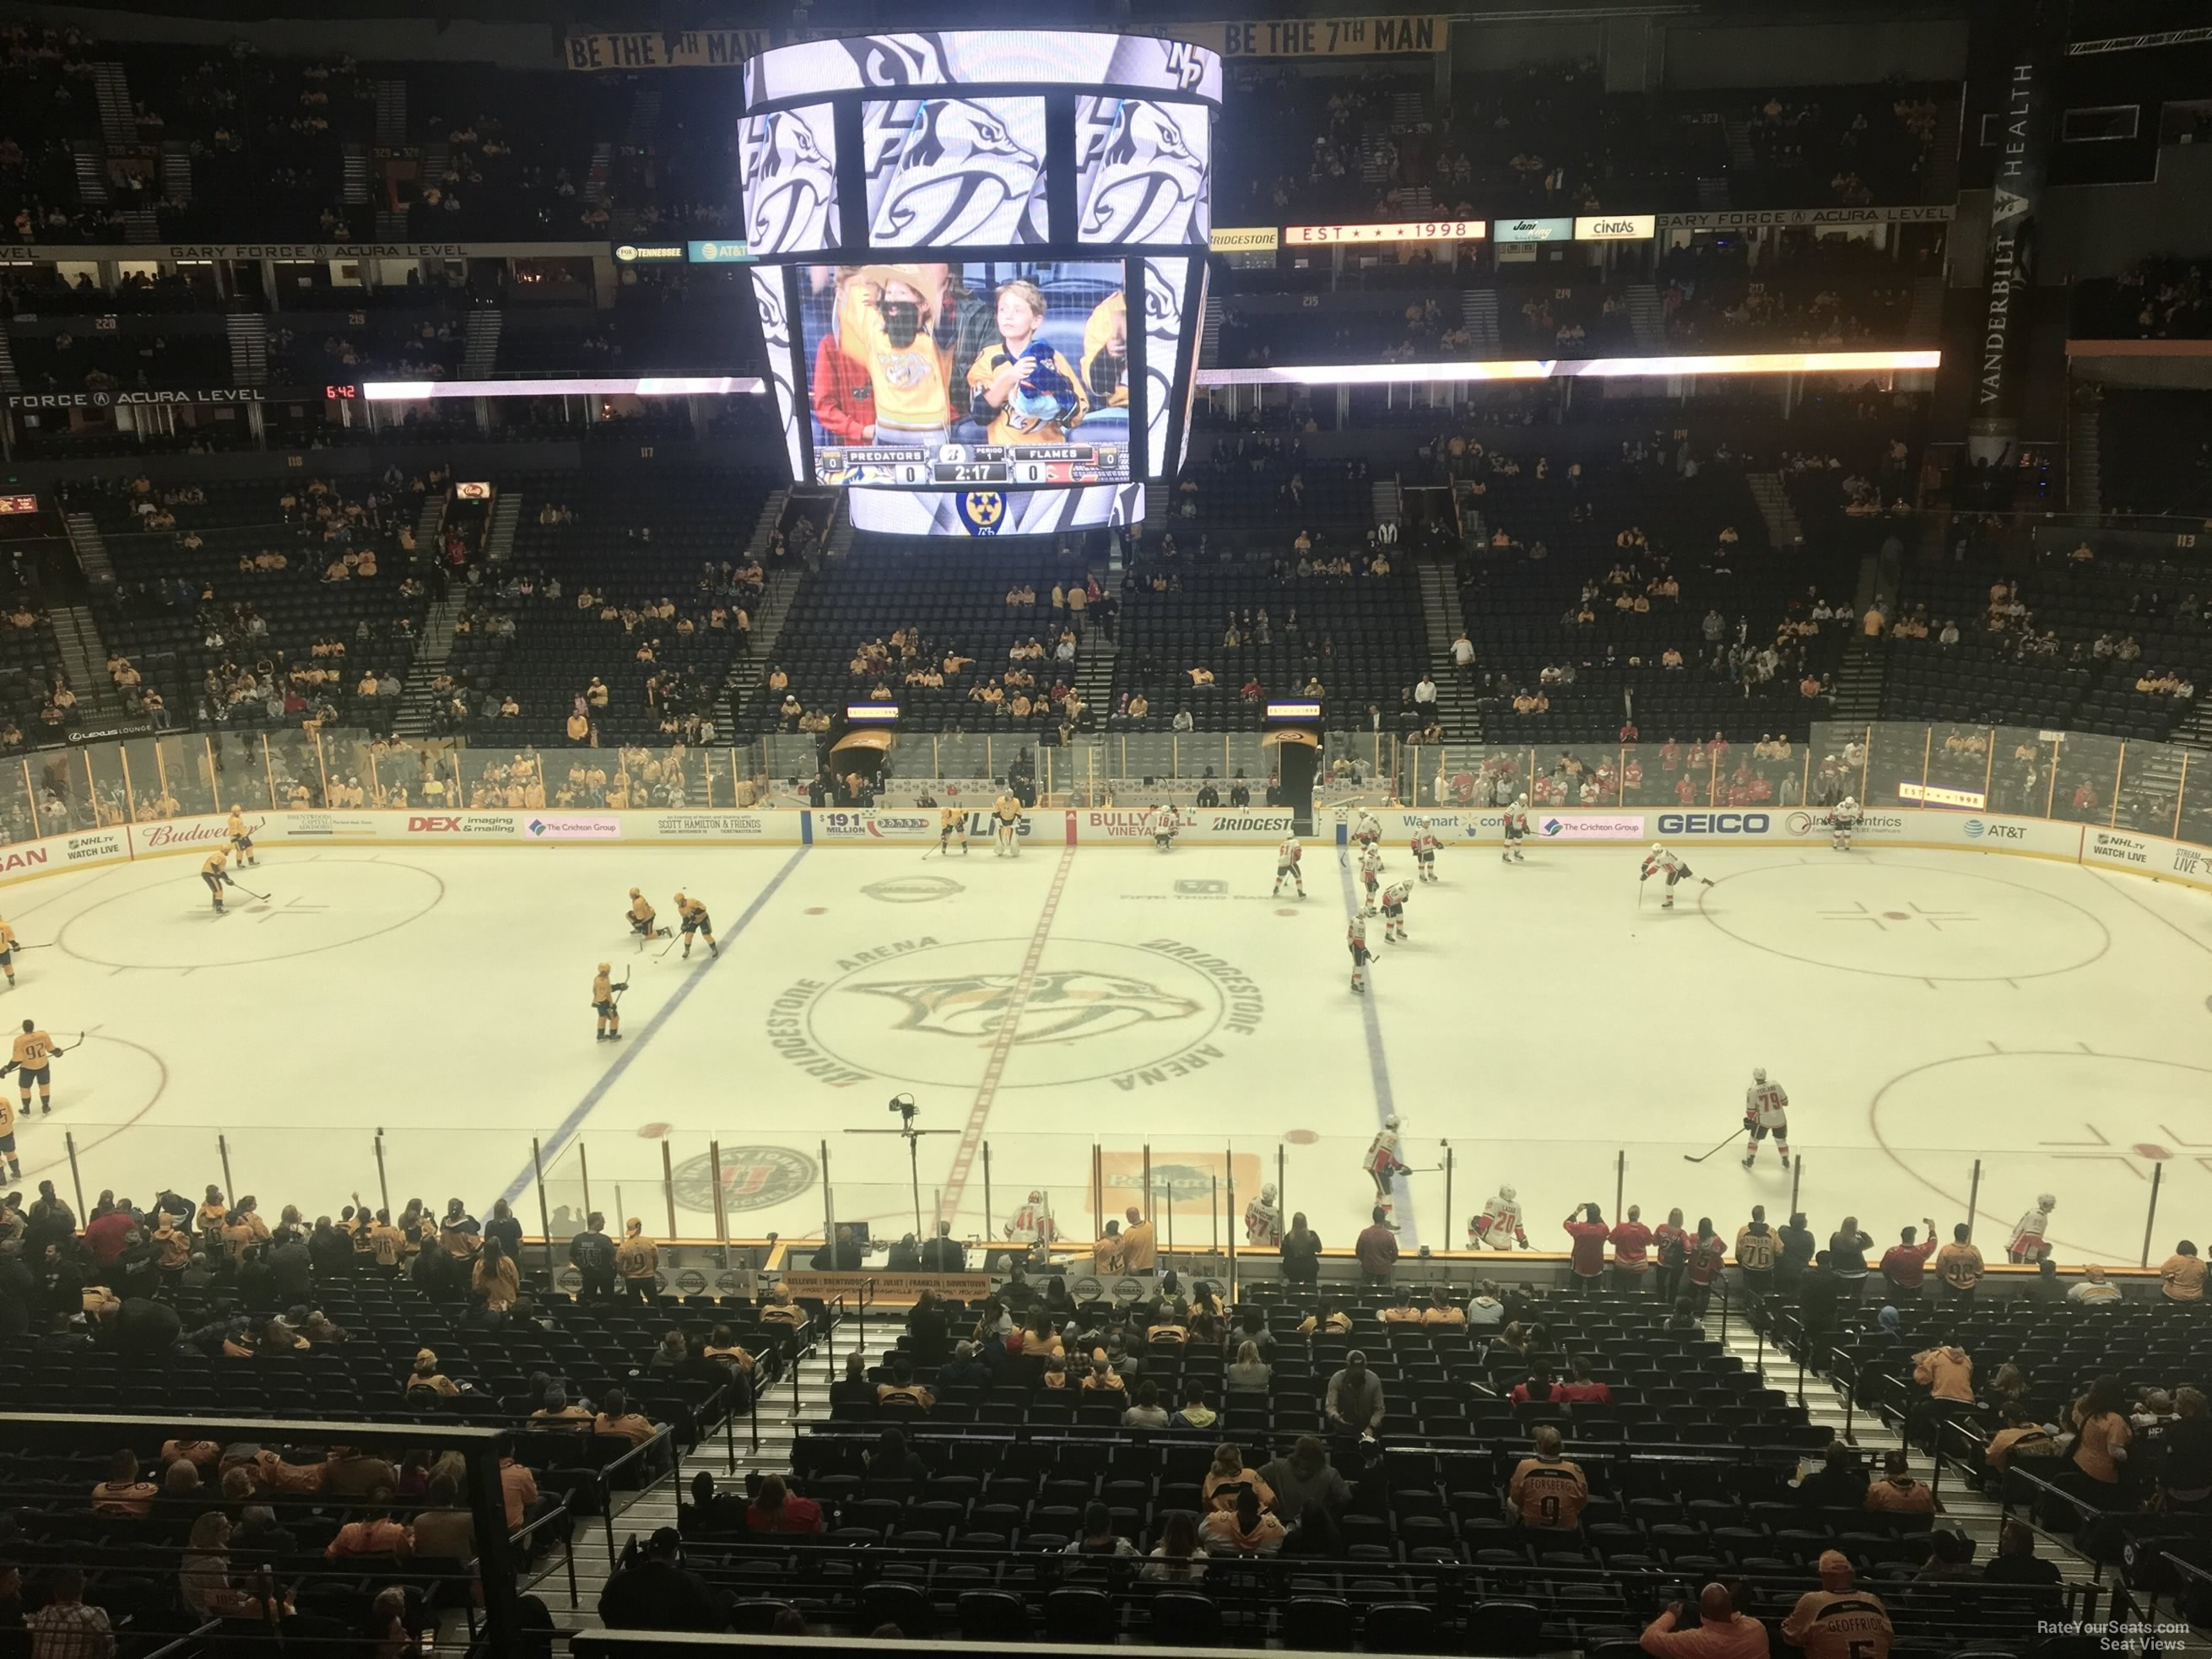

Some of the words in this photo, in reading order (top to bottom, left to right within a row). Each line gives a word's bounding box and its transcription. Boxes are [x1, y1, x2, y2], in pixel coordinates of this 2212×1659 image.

[1224, 22, 1257, 55] BE
[1266, 21, 1316, 53] THE
[1327, 20, 1364, 52] 7TH
[1375, 18, 1434, 51] MAN
[570, 36, 602, 68] BE
[608, 35, 656, 66] THE
[706, 31, 762, 63] MAN
[2004, 64, 2032, 176] HEALTH
[1513, 220, 1538, 230] Jani
[1657, 215, 1710, 227] GARY
[1718, 213, 1785, 224] FORCE
[1811, 210, 1879, 222] ACURA
[1887, 208, 1950, 219] LEVEL
[1302, 228, 1344, 241] EST
[1414, 223, 1467, 237] 1998
[170, 246, 232, 257] GARY
[235, 246, 306, 257] FORCE
[337, 246, 398, 257] ACURA
[405, 245, 468, 256] LEVEL
[636, 247, 682, 257] TENNESSEE
[1303, 295, 1318, 307] 215
[1980, 235, 2015, 405] VANDERBILT
[9, 394, 88, 408] FORCE
[117, 391, 190, 404] ACURA
[197, 388, 265, 402] LEVEL
[327, 386, 355, 398] 6:42
[830, 458, 837, 468] 0
[850, 451, 924, 462] PREDATORS
[1030, 451, 1077, 459] FLAMES
[1107, 454, 1115, 464] 0
[906, 467, 915, 483] 0
[955, 464, 991, 481] 2:17
[1029, 465, 1038, 482] 0
[82, 729, 118, 739] LEXUS
[118, 726, 152, 735] LOUNGE
[408, 817, 463, 832] DEX
[467, 817, 514, 826] imaging
[658, 819, 682, 829] SCOTT
[684, 819, 721, 829] HAMILTON
[722, 819, 728, 829] &
[731, 819, 761, 829] FRIENDS
[1090, 813, 1148, 826] BULLY
[1159, 815, 1170, 827] 18
[1657, 813, 1770, 834] GEICO
[473, 824, 515, 833] mailing
[593, 824, 616, 833] Group
[1611, 824, 1639, 833] Group
[1988, 825, 2027, 839] AT&T
[80, 835, 114, 846] NHL.TV
[2109, 836, 2146, 851] NHL.TV
[68, 847, 99, 861] WATCH
[100, 845, 119, 856] LIVE
[2093, 845, 2125, 858] WATCH
[2127, 851, 2148, 862] LIVE
[2176, 847, 2202, 860] STREAM
[2173, 857, 2199, 873] LIVE
[836, 936, 940, 971] ARENA
[1134, 938, 1266, 1036] BRIDGESTONE
[765, 977, 876, 1089] BRIDGESTONE
[25, 1042, 46, 1061] 92
[1109, 1043, 1226, 1091] ARENA
[1758, 1092, 1781, 1112] 79
[1016, 1210, 1035, 1230] 41
[1249, 1215, 1269, 1238] 27
[1494, 1211, 1516, 1233] 20
[1745, 1245, 1770, 1266] 76
[787, 1277, 818, 1286] BELLEVUE
[946, 1280, 986, 1289] DOWNTOWN
[1530, 1478, 1571, 1492] FORSBERG
[1539, 1494, 1560, 1527] 9
